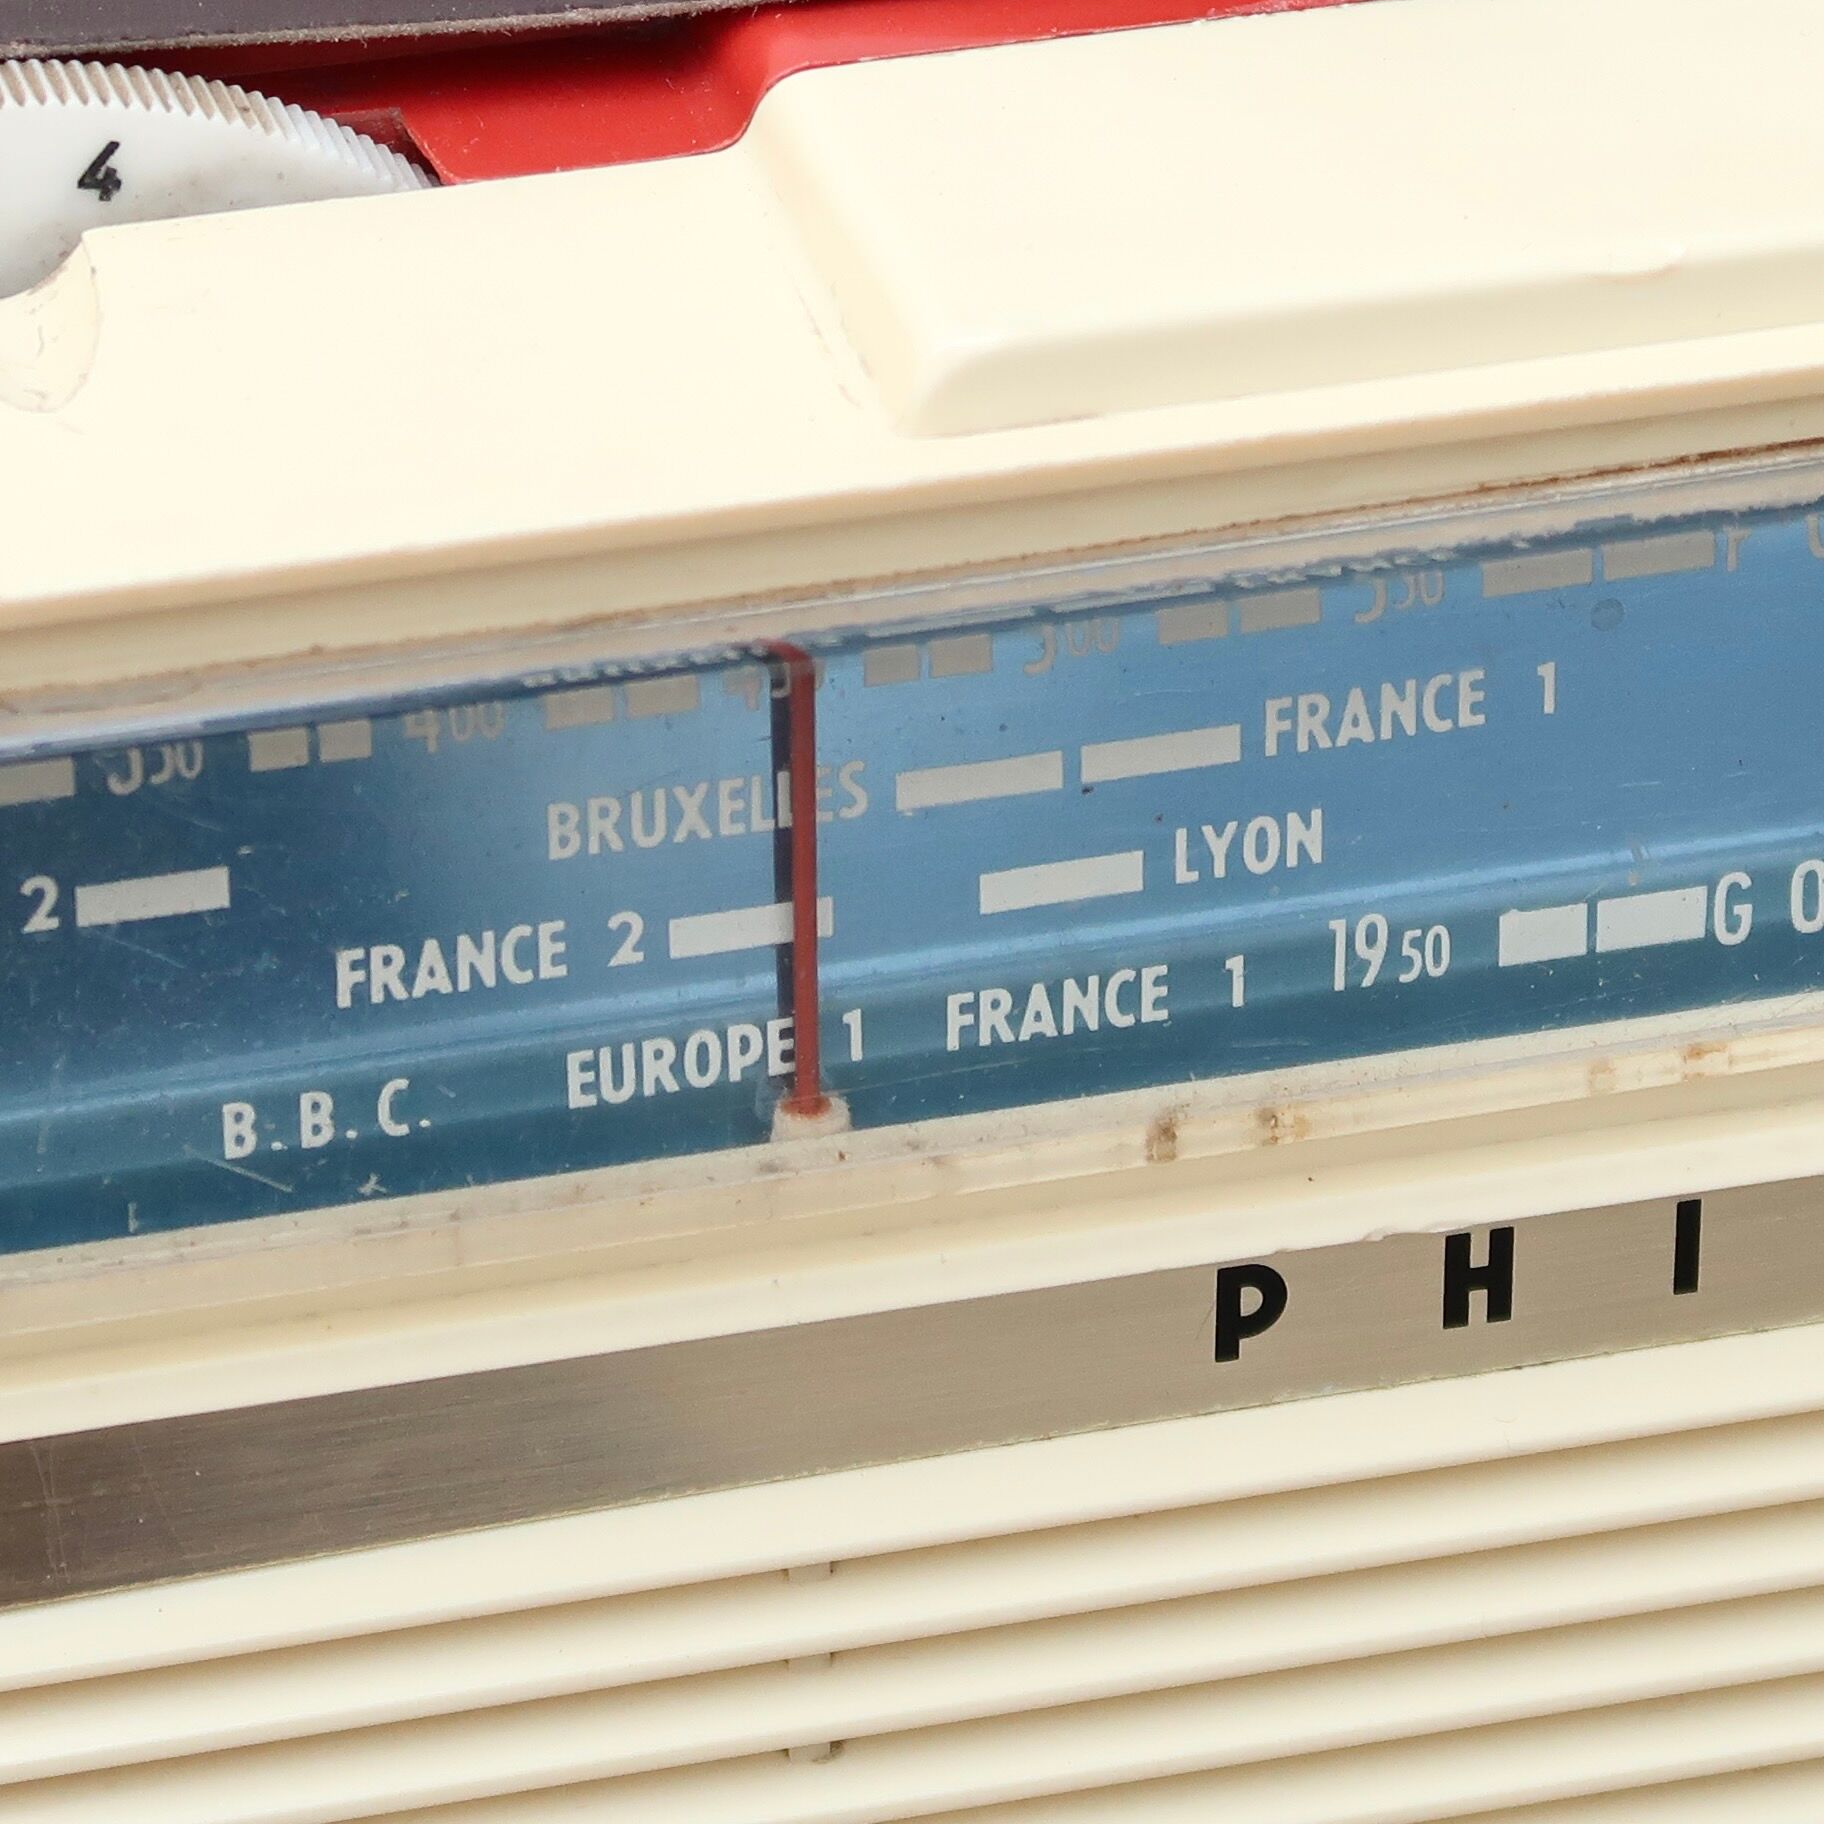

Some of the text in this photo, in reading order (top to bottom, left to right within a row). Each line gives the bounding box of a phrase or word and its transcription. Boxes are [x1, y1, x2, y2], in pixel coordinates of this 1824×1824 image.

[77, 141, 122, 202] 4
[1265, 661, 1556, 756] FRANCE 1
[1175, 808, 1323, 884] LYON
[20, 875, 60, 934] 2
[336, 911, 645, 1008] FRANCE 2
[947, 954, 1244, 1051] FRANCE 1
[567, 1008, 863, 1110] EUROPE 1
